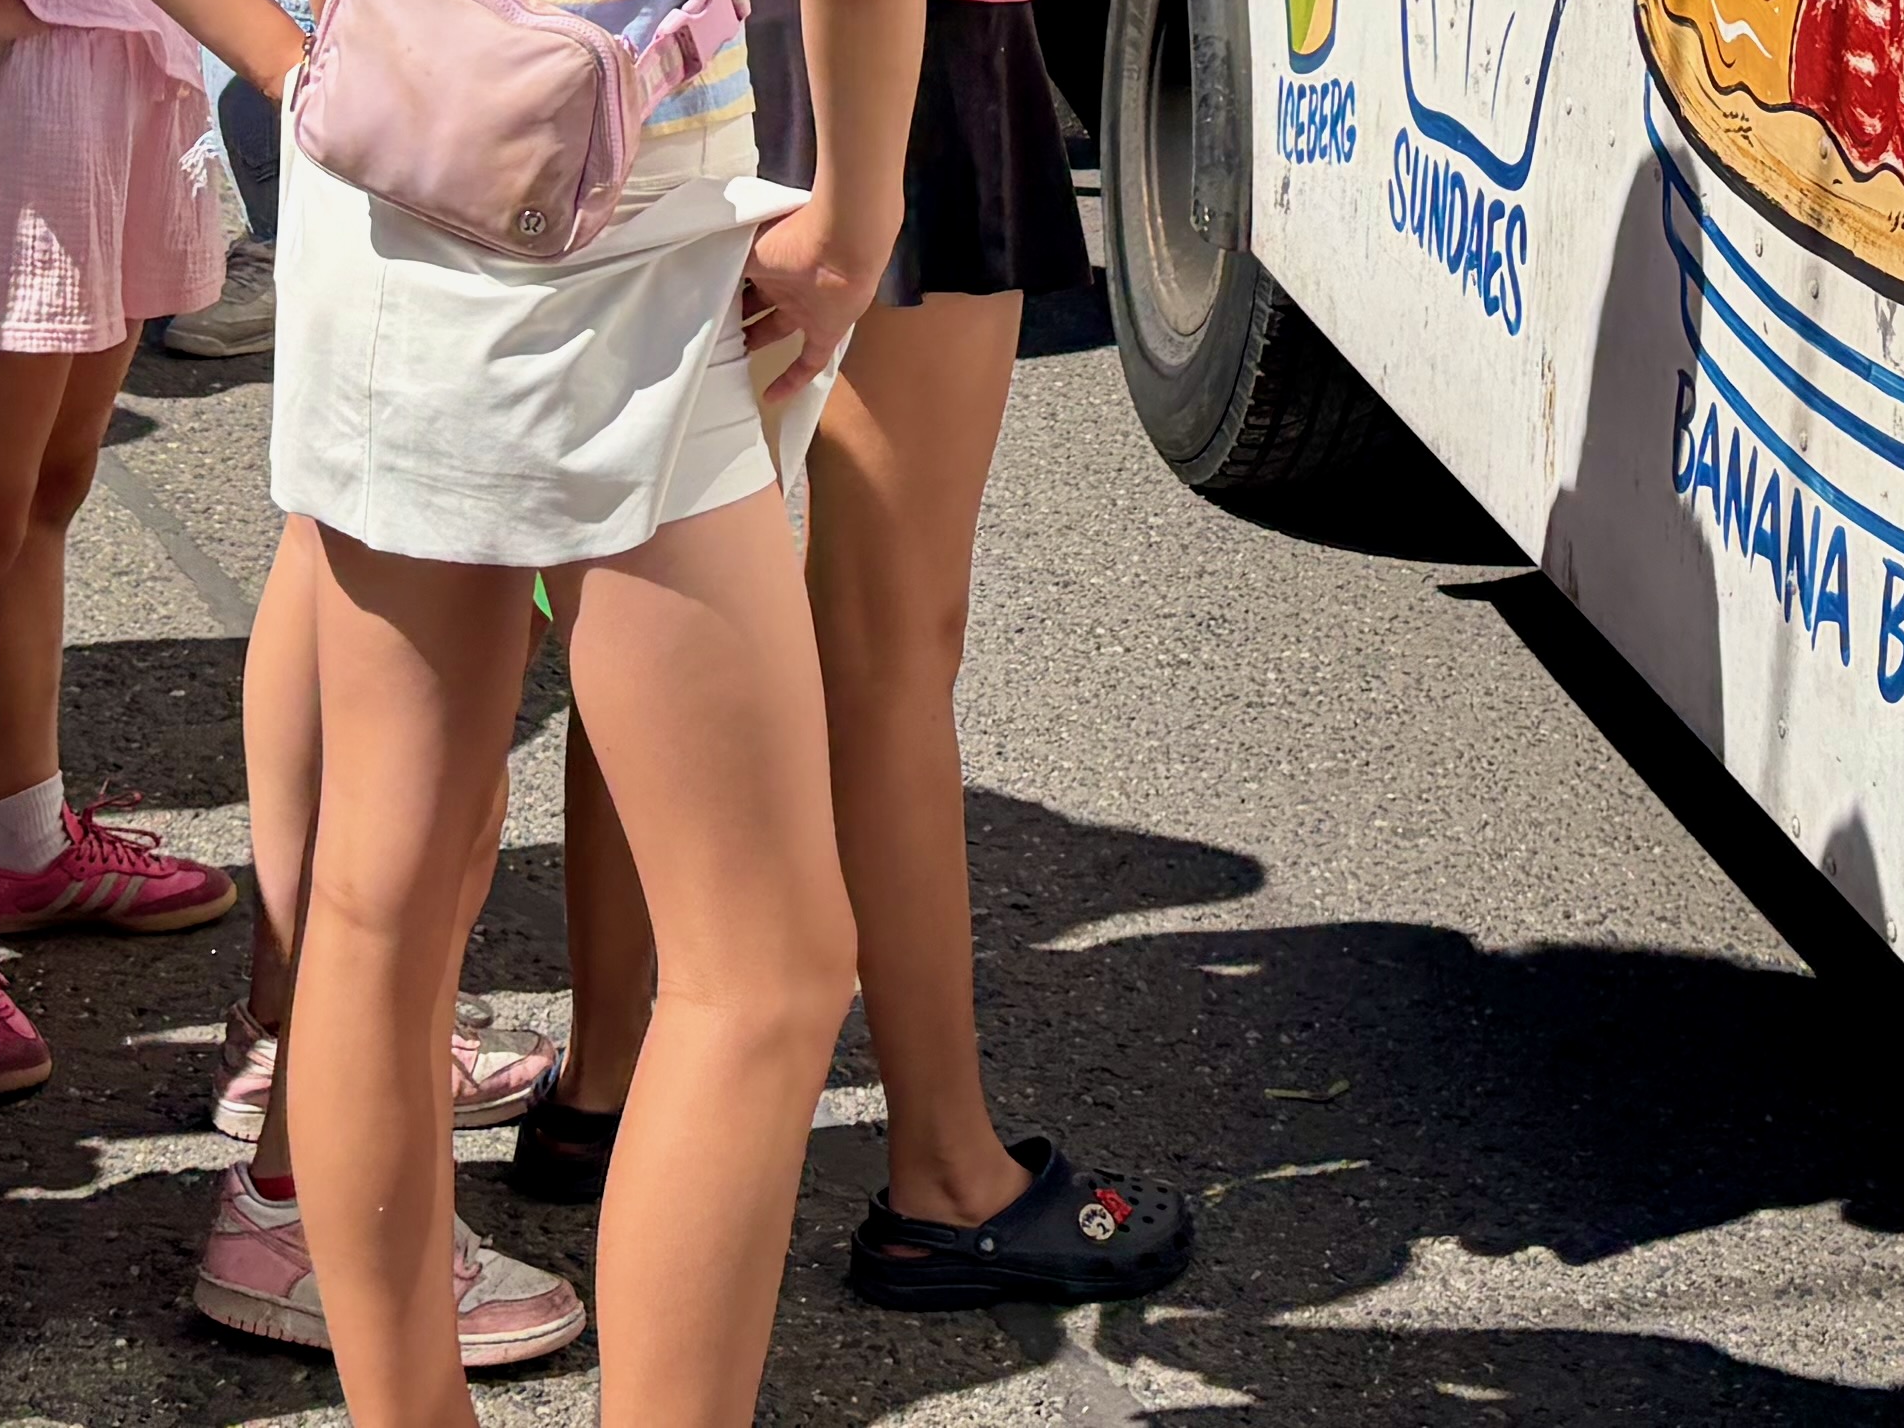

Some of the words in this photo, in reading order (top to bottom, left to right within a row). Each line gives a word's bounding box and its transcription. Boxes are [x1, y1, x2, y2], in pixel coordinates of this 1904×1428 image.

[1276, 76, 1357, 164] ICEBERG
[1388, 127, 1527, 337] SUNDAES
[1672, 369, 1850, 670] BANANA
